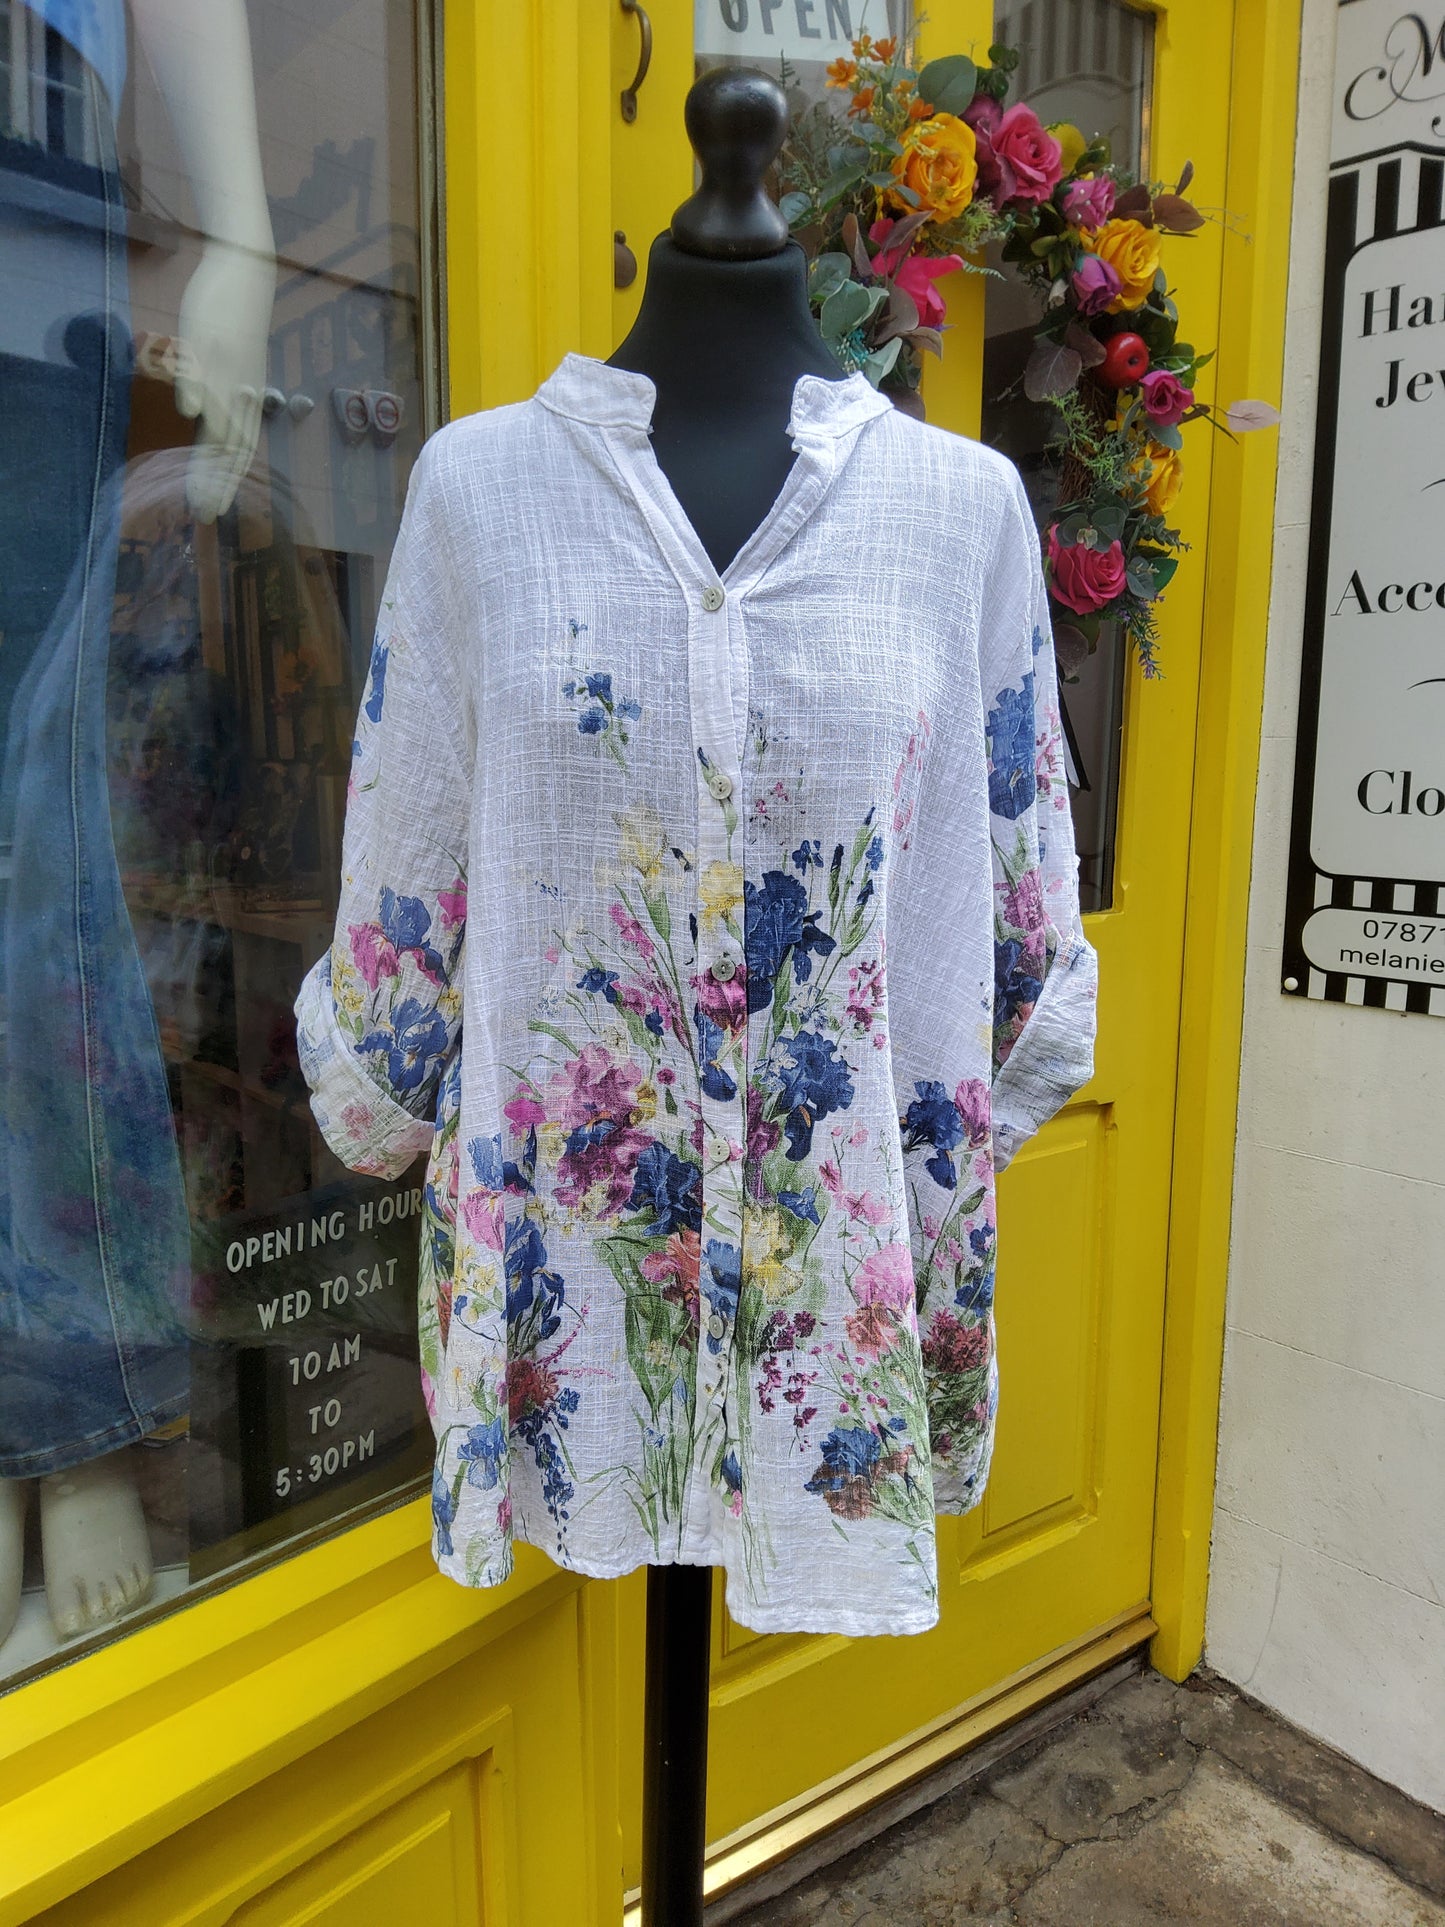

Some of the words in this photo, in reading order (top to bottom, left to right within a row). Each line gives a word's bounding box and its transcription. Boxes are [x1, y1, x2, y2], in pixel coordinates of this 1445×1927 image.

[1357, 283, 1445, 338] Ha
[1357, 769, 1445, 817] Clo
[1340, 948, 1445, 973] melanie
[226, 1211, 345, 1273] OPENING
[257, 1289, 312, 1331] WED
[320, 1275, 350, 1310] TO
[355, 1257, 398, 1298] SAT
[308, 1398, 342, 1435] TO
[275, 1429, 375, 1497] 5:30PM
